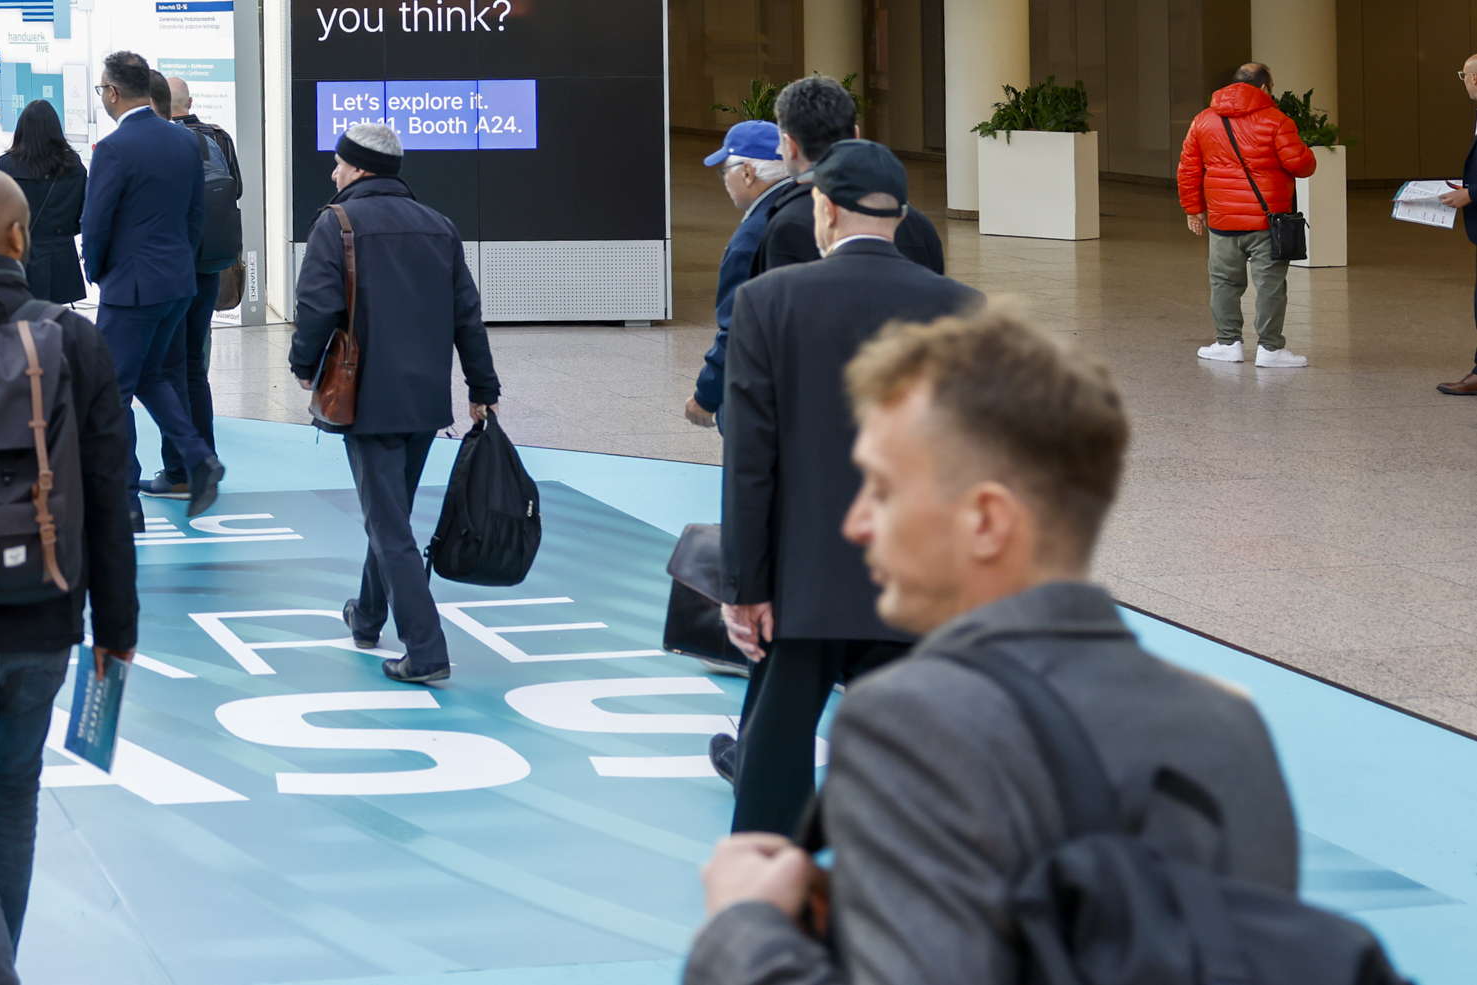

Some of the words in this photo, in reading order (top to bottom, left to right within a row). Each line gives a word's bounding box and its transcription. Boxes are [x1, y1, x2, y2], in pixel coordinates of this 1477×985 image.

[316, 7, 384, 41] you
[399, 0, 512, 32] think?
[8, 32, 45, 42] handwerk
[36, 44, 49, 53] live
[388, 92, 463, 114] explore
[469, 92, 489, 110] it.
[408, 117, 467, 135] Booth
[474, 115, 523, 134] A24.
